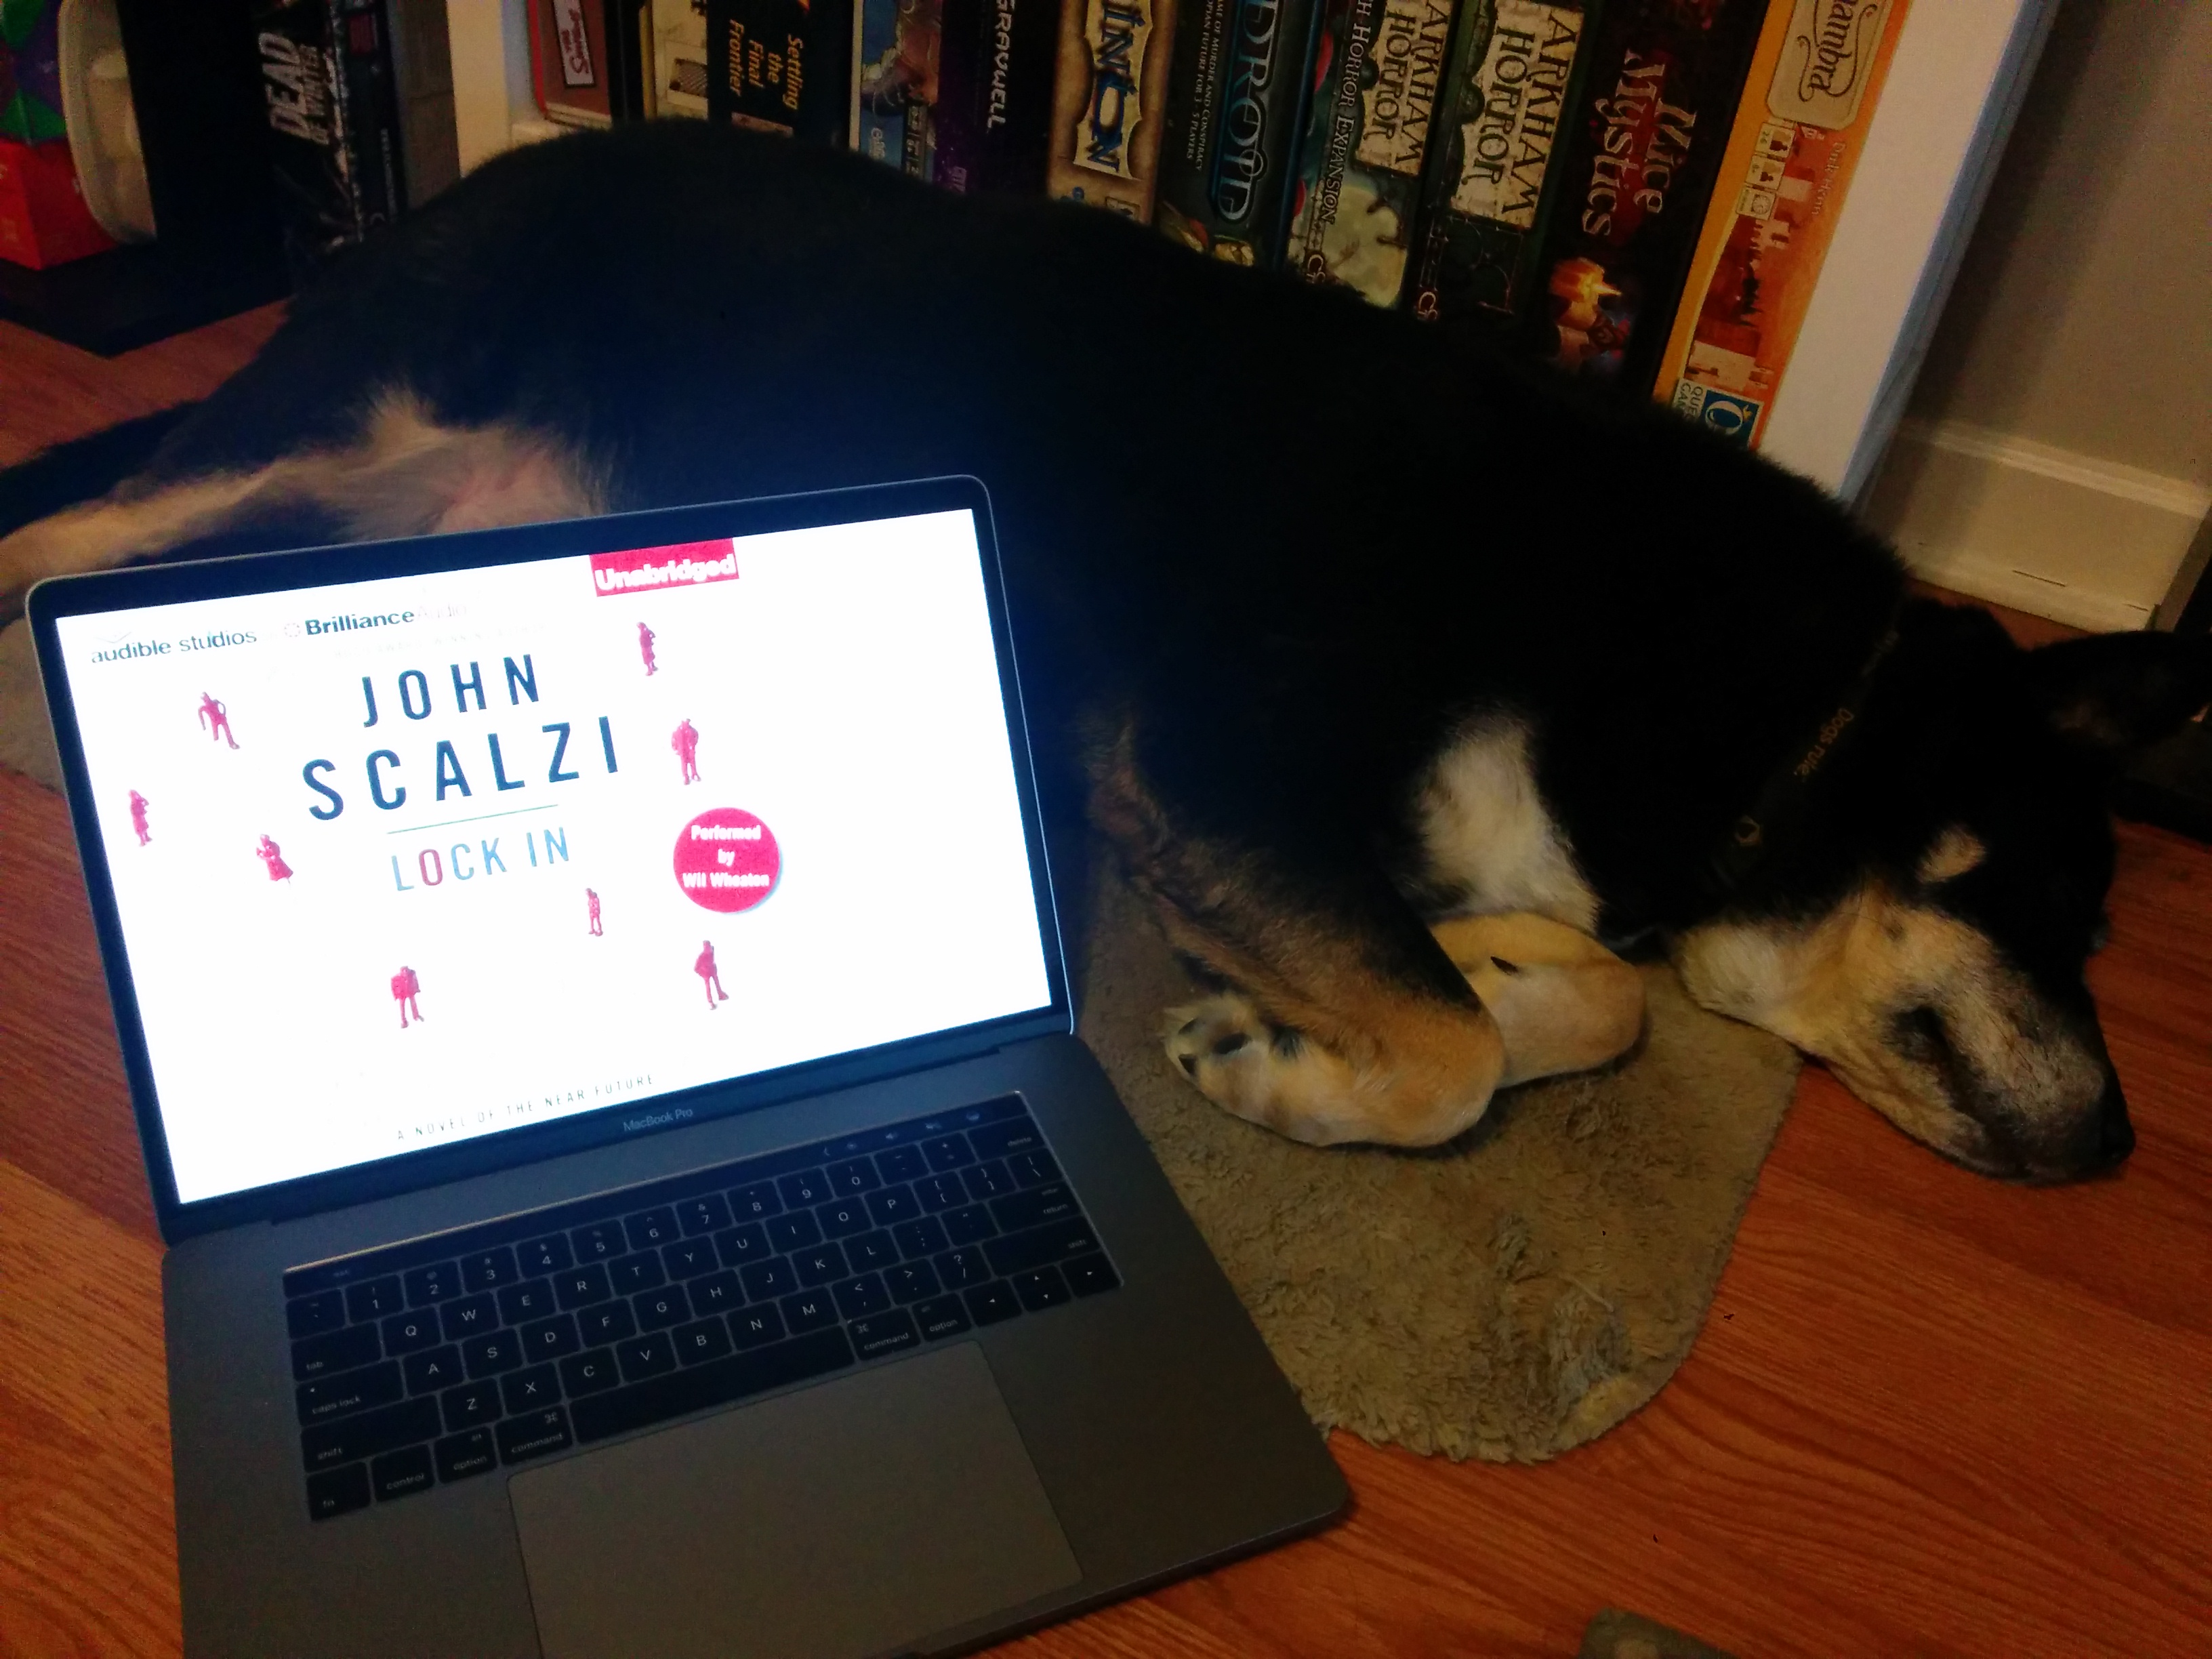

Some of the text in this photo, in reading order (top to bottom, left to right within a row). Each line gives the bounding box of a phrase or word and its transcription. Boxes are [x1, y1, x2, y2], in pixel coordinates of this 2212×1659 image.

[729, 18, 745, 97] Frontier
[1196, 32, 1211, 70] FUTURE
[1205, 37, 1221, 82] MURDER
[1213, 20, 1223, 35] OF
[258, 31, 306, 140] DEAD
[747, 39, 765, 89] Final
[766, 51, 785, 85] the
[1194, 73, 1205, 94] FOR
[1203, 84, 1214, 107] AND
[1338, 23, 1372, 108] HORROR
[1361, 12, 1418, 140] HORROR
[1395, 2, 1448, 164] ARKHAM
[1187, 120, 1199, 161] PLAYERS
[1461, 25, 1536, 186] HORROR
[1501, 12, 1577, 215] ARKHAM
[1319, 115, 1355, 225] EXPANSION
[1581, 47, 1666, 236] Mystics
[1633, 98, 1697, 213] Mice
[594, 554, 737, 592] Unabridged
[91, 630, 258, 665] audible studios
[304, 608, 415, 636] Brilliance
[362, 654, 539, 729] JOHN
[1820, 707, 1855, 745] Dogs
[302, 716, 619, 821] SCALZI
[391, 826, 569, 892] LOCK IN
[718, 848, 735, 867] by
[415, 1115, 467, 1137] NOVEL
[506, 1100, 534, 1117] THE
[545, 1088, 586, 1108] NEAR
[594, 1073, 655, 1097] FUTURE
[623, 1107, 694, 1132] MacBook Pro
[372, 1298, 380, 1309] 1
[429, 1283, 439, 1296] 2
[486, 1269, 496, 1281] 3
[541, 1254, 552, 1265] 4
[595, 1242, 606, 1252] 5
[648, 1227, 659, 1239] 6
[702, 1214, 710, 1225] 7
[751, 1201, 762, 1212] 8
[801, 1188, 813, 1200] 9
[851, 1176, 861, 1186] 0
[405, 1325, 417, 1337] Q
[461, 1309, 476, 1322] W
[520, 1294, 533, 1307] E
[575, 1279, 588, 1292] R
[632, 1265, 640, 1276] T
[684, 1252, 694, 1263] Y
[735, 1237, 749, 1250] U
[790, 1225, 797, 1235] I
[837, 1211, 850, 1223] O
[886, 1198, 897, 1210] P
[428, 1362, 440, 1375] A
[486, 1346, 499, 1359] S
[544, 1331, 557, 1344] D
[601, 1316, 611, 1328] F
[655, 1300, 668, 1313] G
[709, 1286, 722, 1298] H
[766, 1272, 774, 1284] J
[814, 1258, 826, 1270] K
[865, 1246, 876, 1256] L
[466, 1397, 476, 1411] Z
[525, 1381, 537, 1394] X
[583, 1365, 595, 1378] C
[639, 1349, 651, 1361] V
[695, 1334, 708, 1347] B
[750, 1318, 763, 1331] N
[802, 1303, 817, 1316] M
